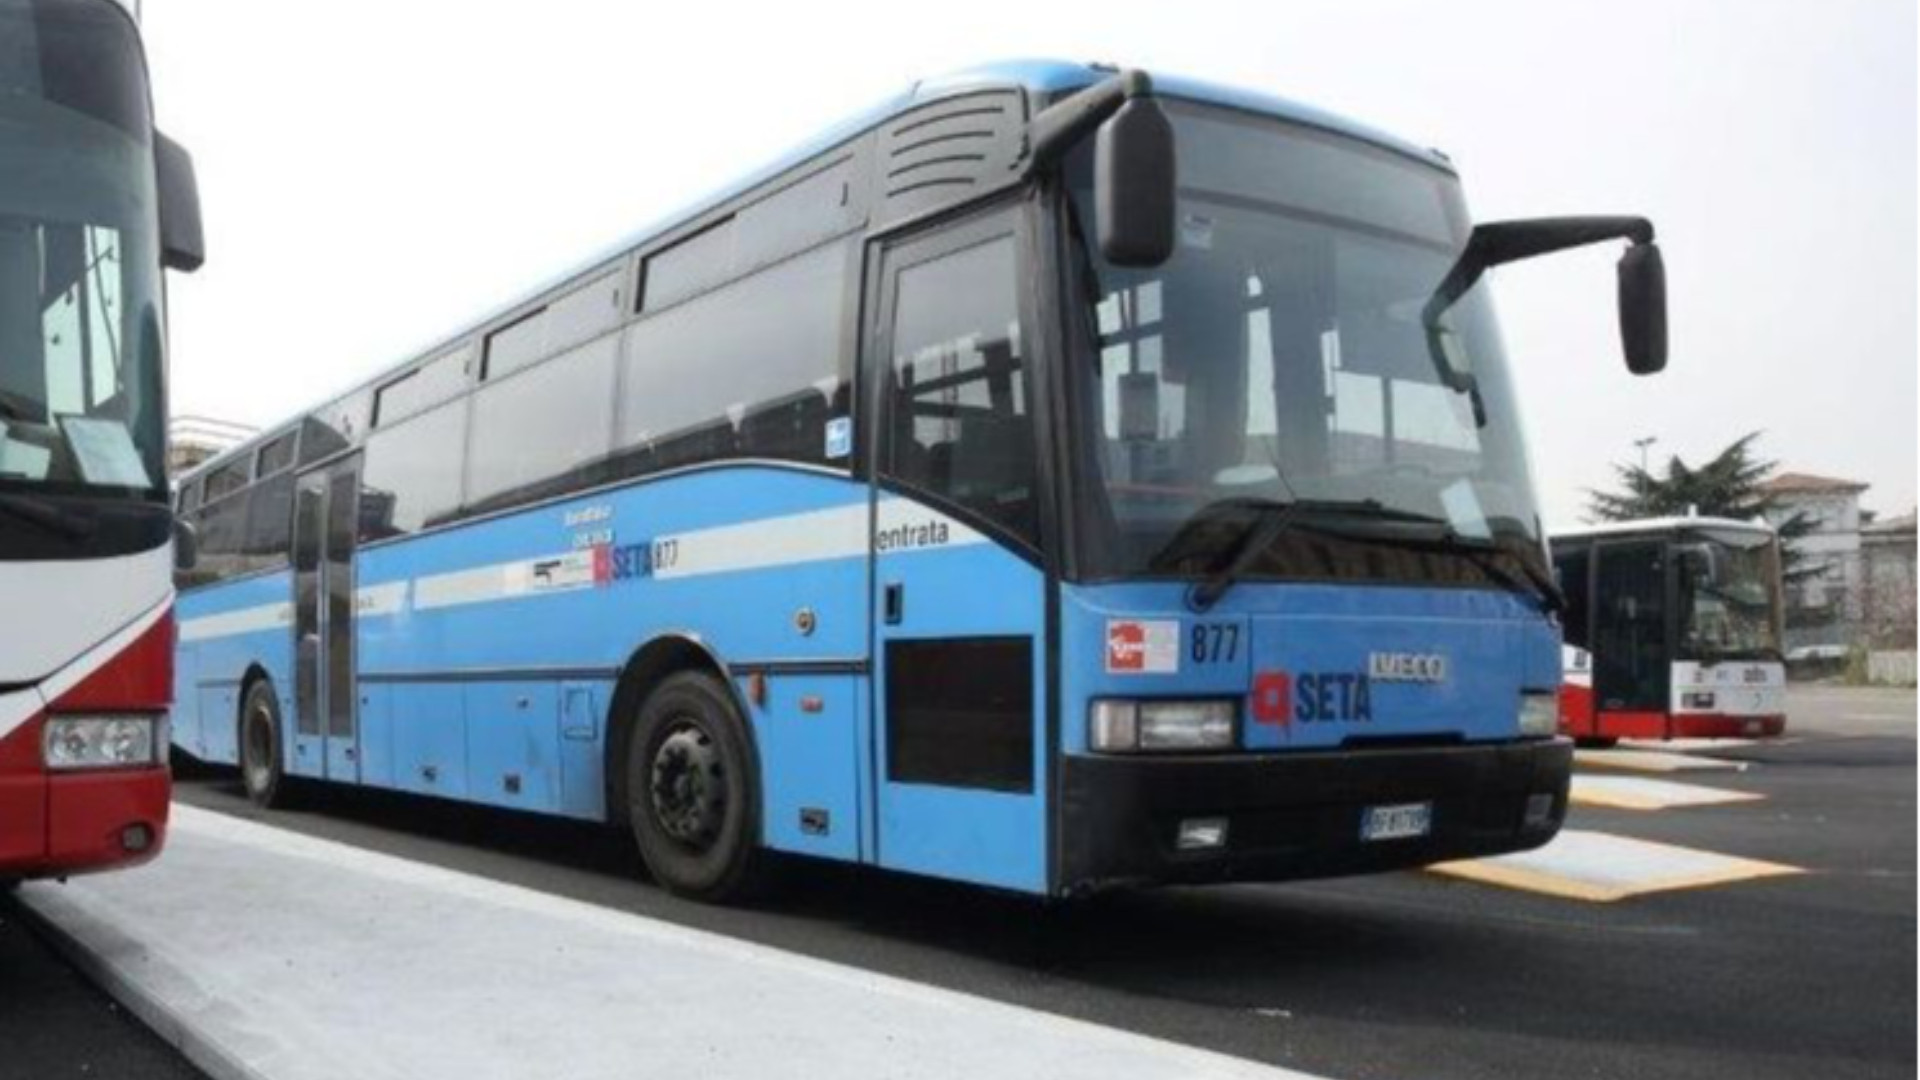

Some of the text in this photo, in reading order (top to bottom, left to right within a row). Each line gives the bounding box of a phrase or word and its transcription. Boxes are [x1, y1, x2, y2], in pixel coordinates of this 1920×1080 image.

[877, 520, 950, 551] entrata
[612, 543, 653, 580] SETA
[1192, 623, 1239, 664] 877
[1368, 651, 1446, 680] IVECO
[1295, 672, 1373, 723] SETA
